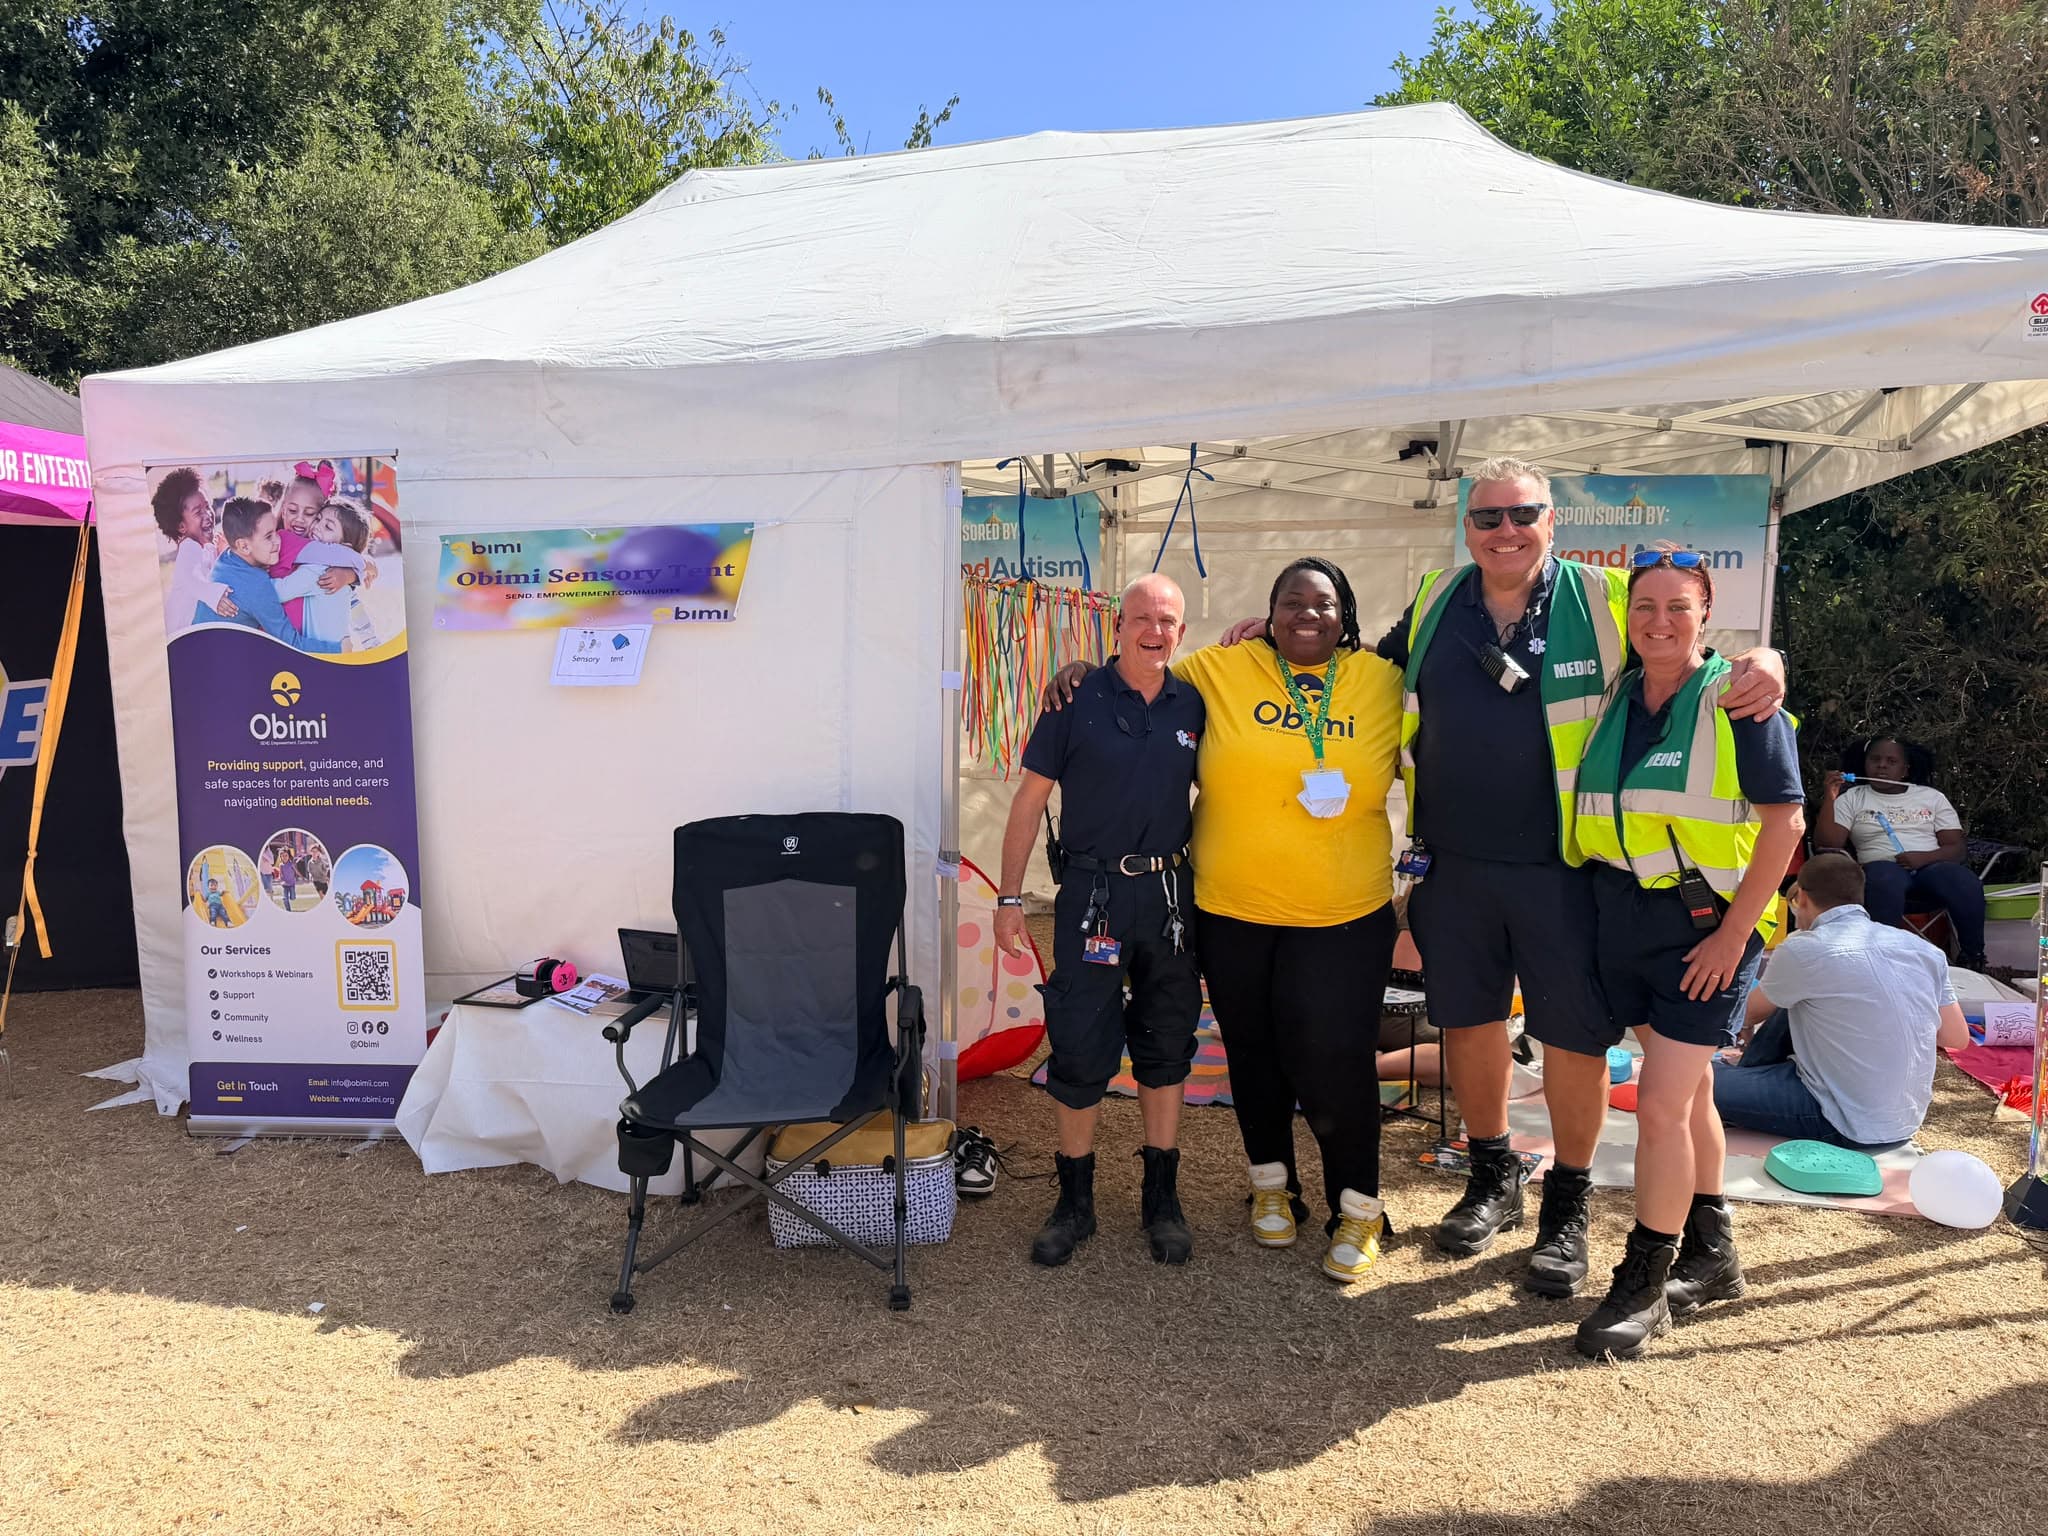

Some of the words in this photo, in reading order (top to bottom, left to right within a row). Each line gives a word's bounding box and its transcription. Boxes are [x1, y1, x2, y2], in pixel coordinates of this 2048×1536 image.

[1555, 506, 1644, 526] SPONSORED
[1646, 505, 1670, 525] BY:
[456, 568, 540, 587] Obimi
[548, 566, 662, 585] Sensory
[667, 563, 736, 580] Tent
[571, 654, 601, 664] Sensory
[610, 655, 625, 663] tent
[1554, 659, 1597, 679] MEDIC
[1253, 700, 1355, 739] Obmi
[250, 713, 328, 740] Obimi
[207, 760, 260, 773] Providing
[262, 759, 307, 772] support,
[309, 758, 361, 771] guidance,
[363, 758, 384, 769] and
[204, 779, 229, 790] safe
[232, 779, 271, 791] spaces
[272, 777, 287, 789] for
[290, 778, 330, 790] parents
[332, 776, 352, 788] and
[354, 778, 389, 787] carers
[224, 796, 278, 809] navigating
[280, 795, 333, 806] additional
[335, 795, 373, 806] needs.
[201, 945, 222, 955] Our
[225, 944, 271, 955] Services
[220, 970, 266, 979] Workshops
[267, 970, 273, 978] &
[275, 969, 314, 979] Webinars
[223, 990, 255, 1000] Support
[224, 1013, 269, 1023] Community
[225, 1034, 263, 1043] Wellness
[350, 1040, 380, 1049] @Obimi
[217, 1081, 236, 1091] Get
[237, 1081, 246, 1091] In
[249, 1081, 279, 1092] Touch
[308, 1079, 330, 1087] Email:
[309, 1094, 341, 1103] Website:
[342, 1095, 395, 1105] www.obimi.org
